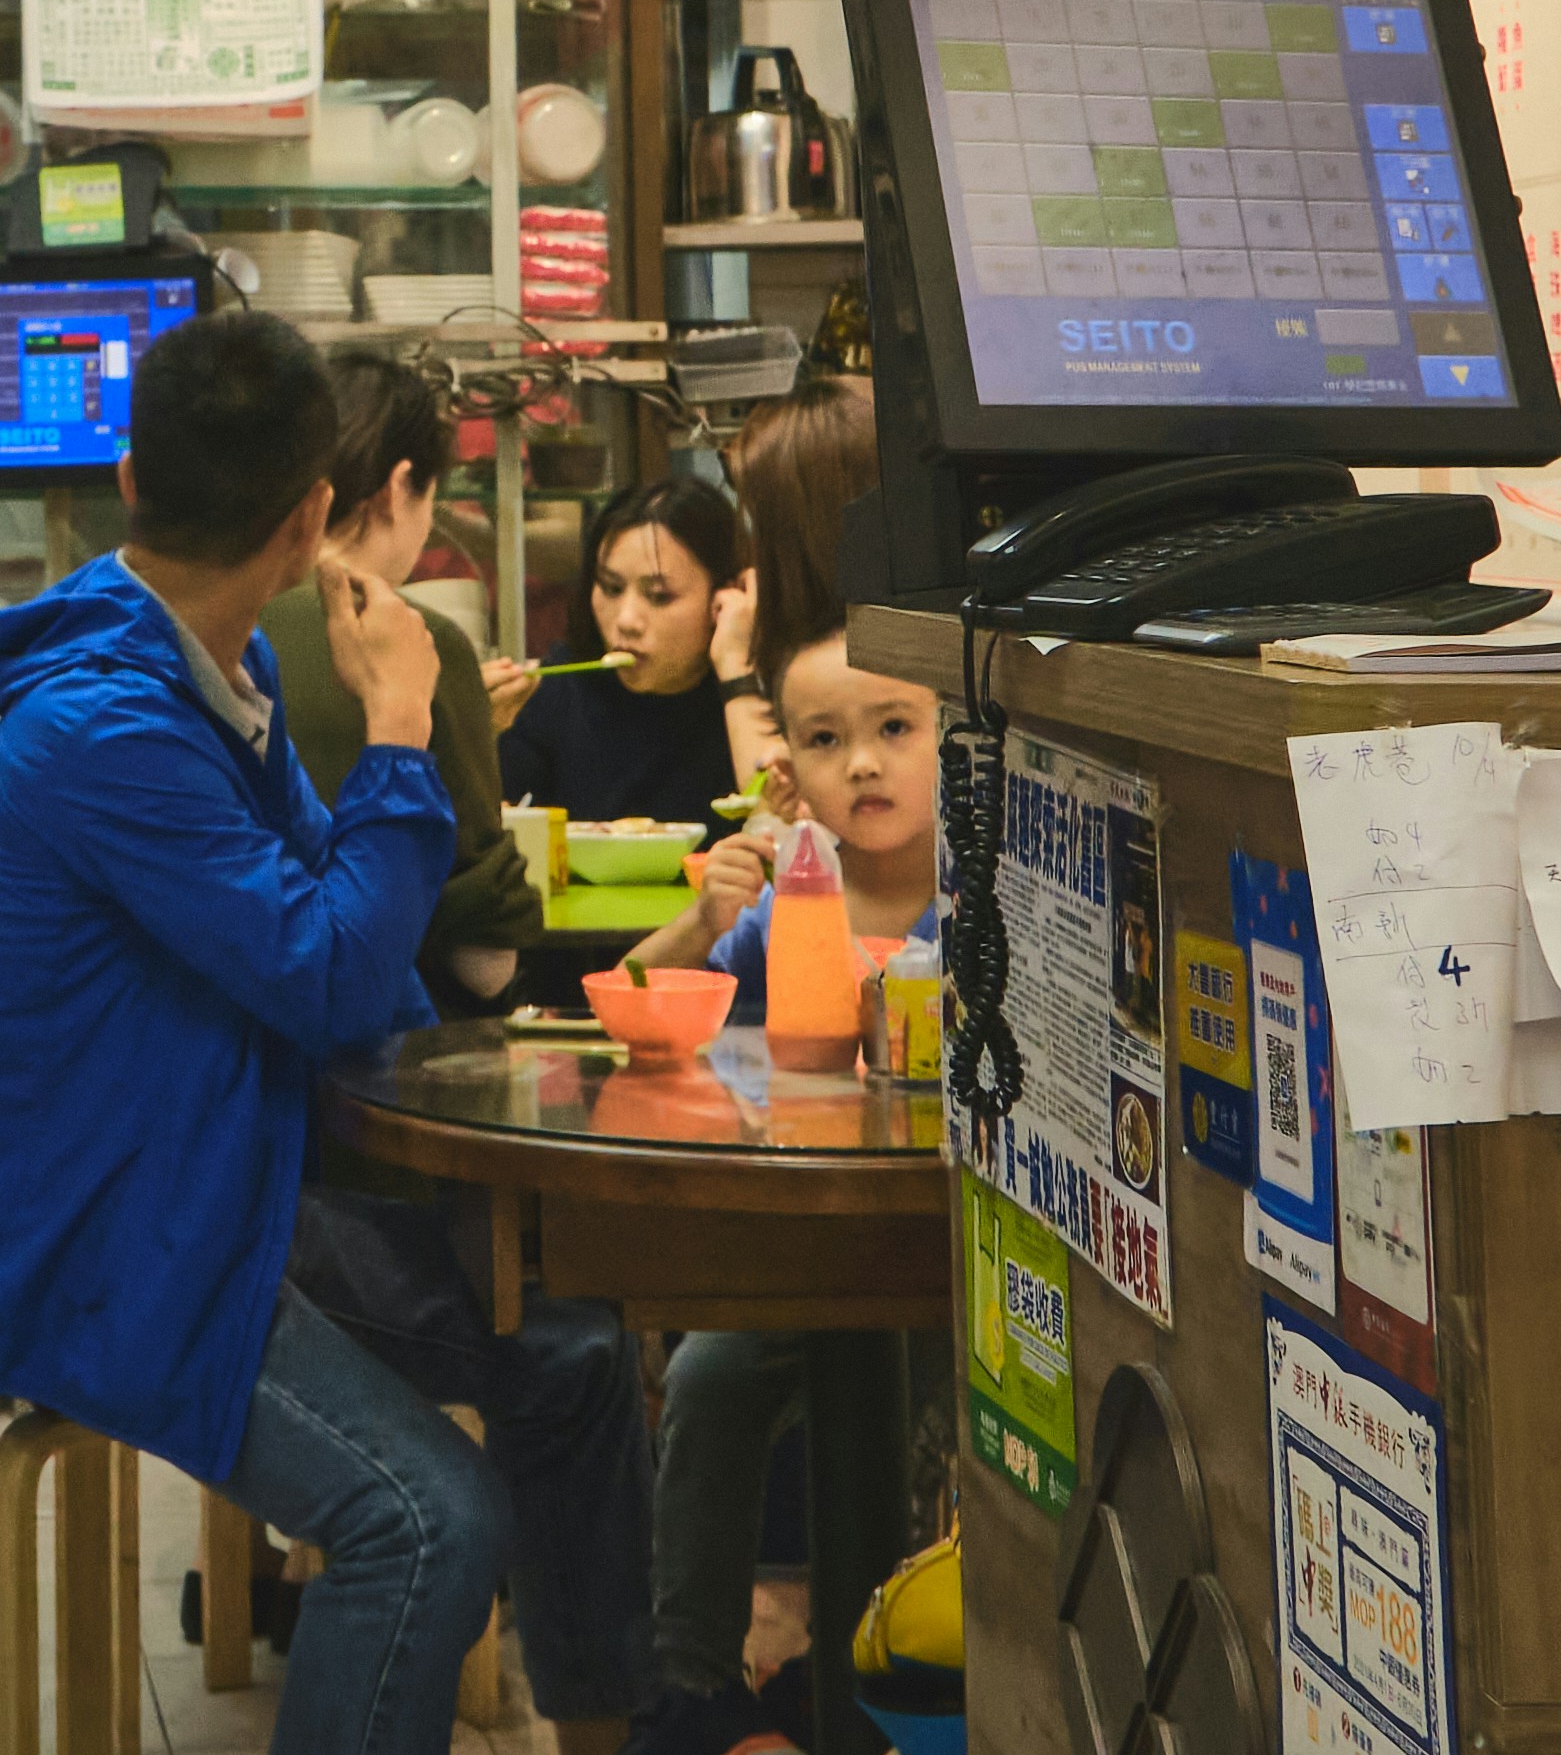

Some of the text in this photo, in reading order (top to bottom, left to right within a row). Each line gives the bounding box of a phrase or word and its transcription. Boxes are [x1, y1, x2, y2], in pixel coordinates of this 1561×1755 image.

[1057, 319, 1197, 354] SEITO
[1088, 361, 1158, 374] MANAGEMENT
[1161, 362, 1202, 374] SYSTEM
[1437, 945, 1471, 988] 4
[1006, 1260, 1065, 1347] 膠袋收費
[1292, 1361, 1406, 1470] 澳門中銀手機銀行
[1350, 1583, 1419, 1666] MOP 188
